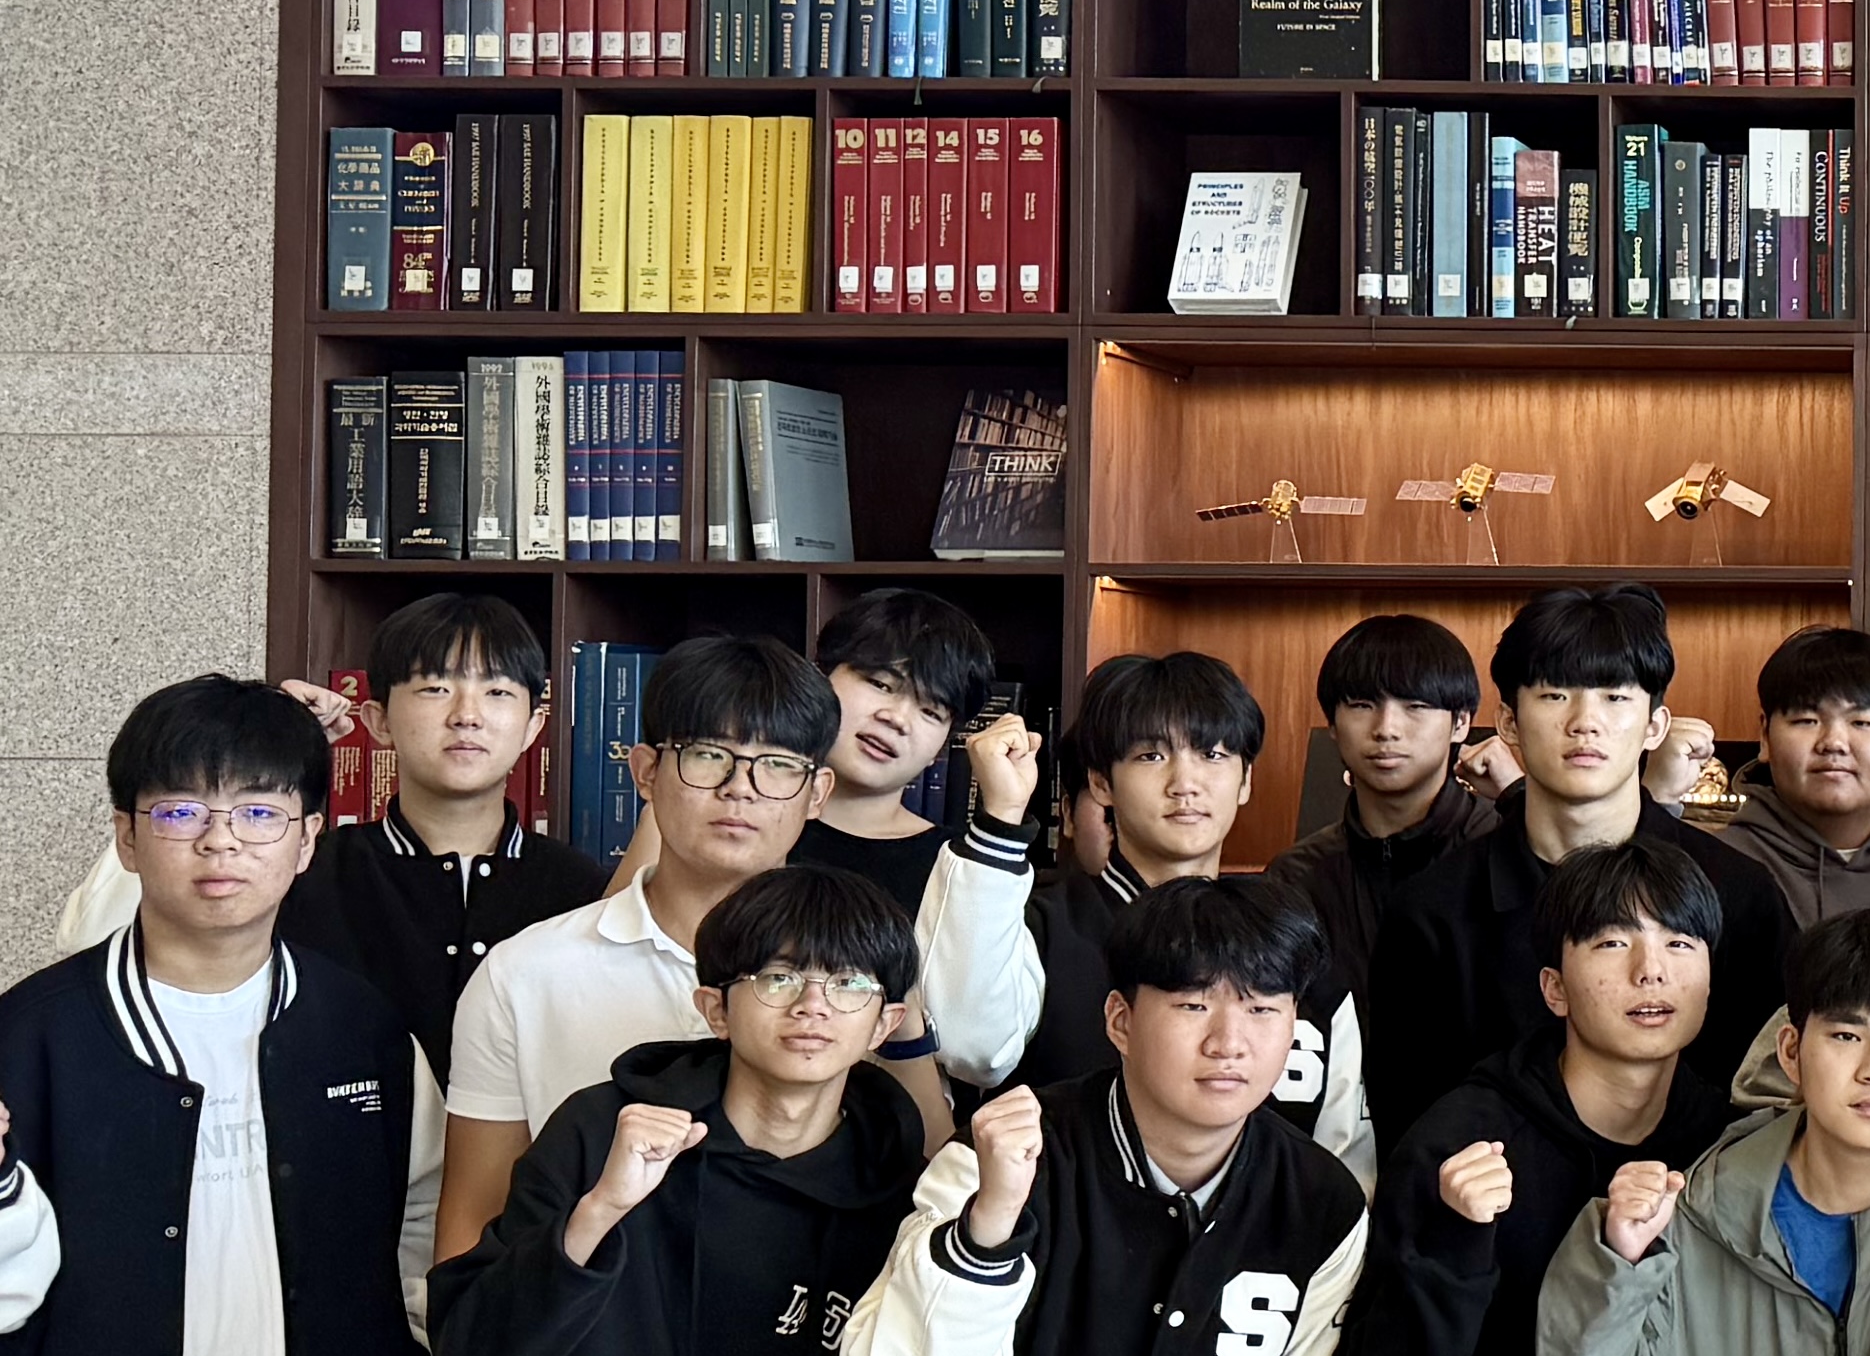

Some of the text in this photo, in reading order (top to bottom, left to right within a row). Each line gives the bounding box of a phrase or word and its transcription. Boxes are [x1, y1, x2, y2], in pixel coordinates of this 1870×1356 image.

[836, 129, 865, 148] 10
[875, 129, 897, 147] 11
[905, 128, 927, 144] 12
[936, 131, 960, 147] 14
[976, 129, 1000, 145] 15
[1019, 130, 1043, 145] 16
[1627, 142, 1645, 156] 21
[1838, 147, 1851, 215] Think It Up
[1624, 160, 1638, 233] HANDBOOK
[1637, 179, 1650, 211] ASM
[1814, 151, 1829, 243] CONTINUOUS
[1516, 205, 1526, 265] HANDBOOK
[1528, 207, 1538, 265] TRANSFER
[1537, 205, 1556, 266] HEAT
[990, 455, 1055, 473] THINK
[340, 676, 358, 697] 2
